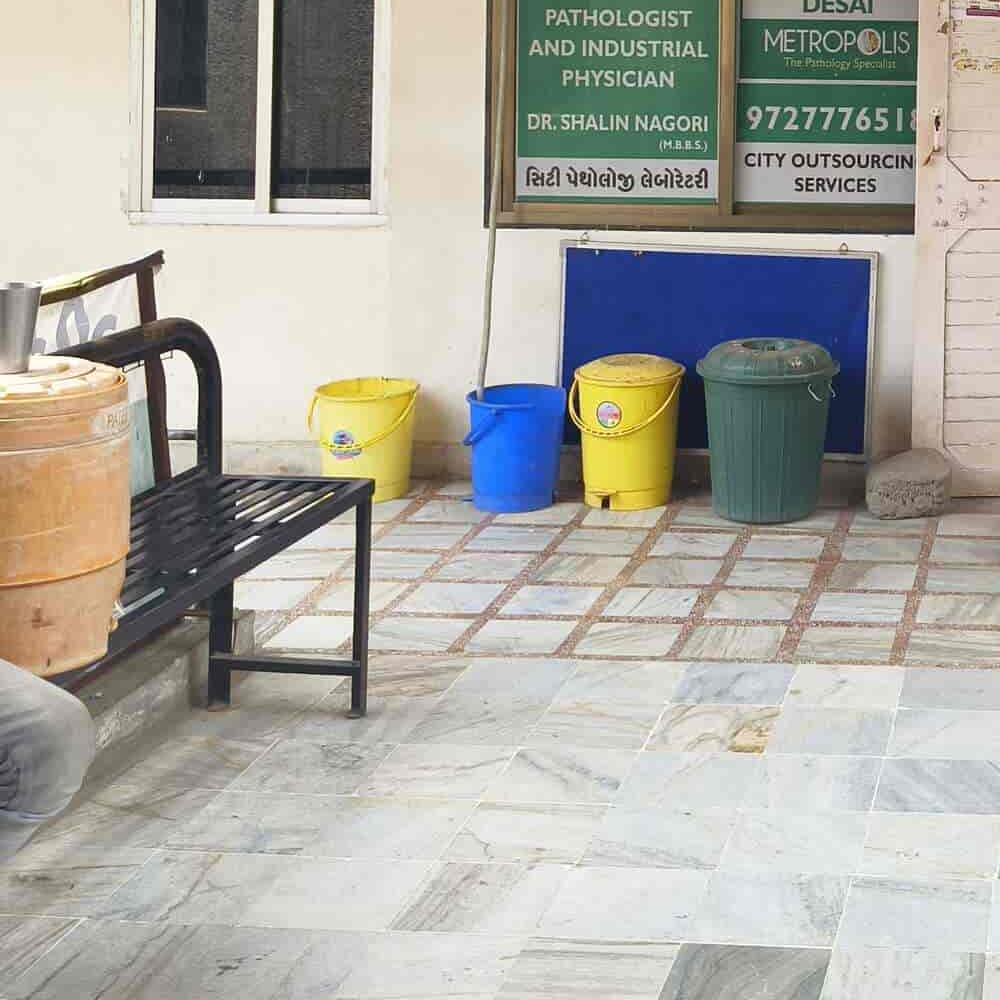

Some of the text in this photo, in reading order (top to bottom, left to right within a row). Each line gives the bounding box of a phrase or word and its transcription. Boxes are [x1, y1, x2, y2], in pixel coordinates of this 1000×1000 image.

[545, 9, 693, 28] PATHOLOGIST
[528, 39, 709, 58] AND INDUSTRIAL
[764, 28, 911, 56] METROPOLIS
[561, 70, 675, 88] PHYSICIAN
[527, 113, 708, 133] DR. SHALIN NAGORI
[658, 140, 708, 153] (M.B.B.S.)
[744, 152, 914, 169] CITY OUTSOURCIN
[526, 166, 561, 188] સિટી
[794, 177, 877, 193] SERVICES
